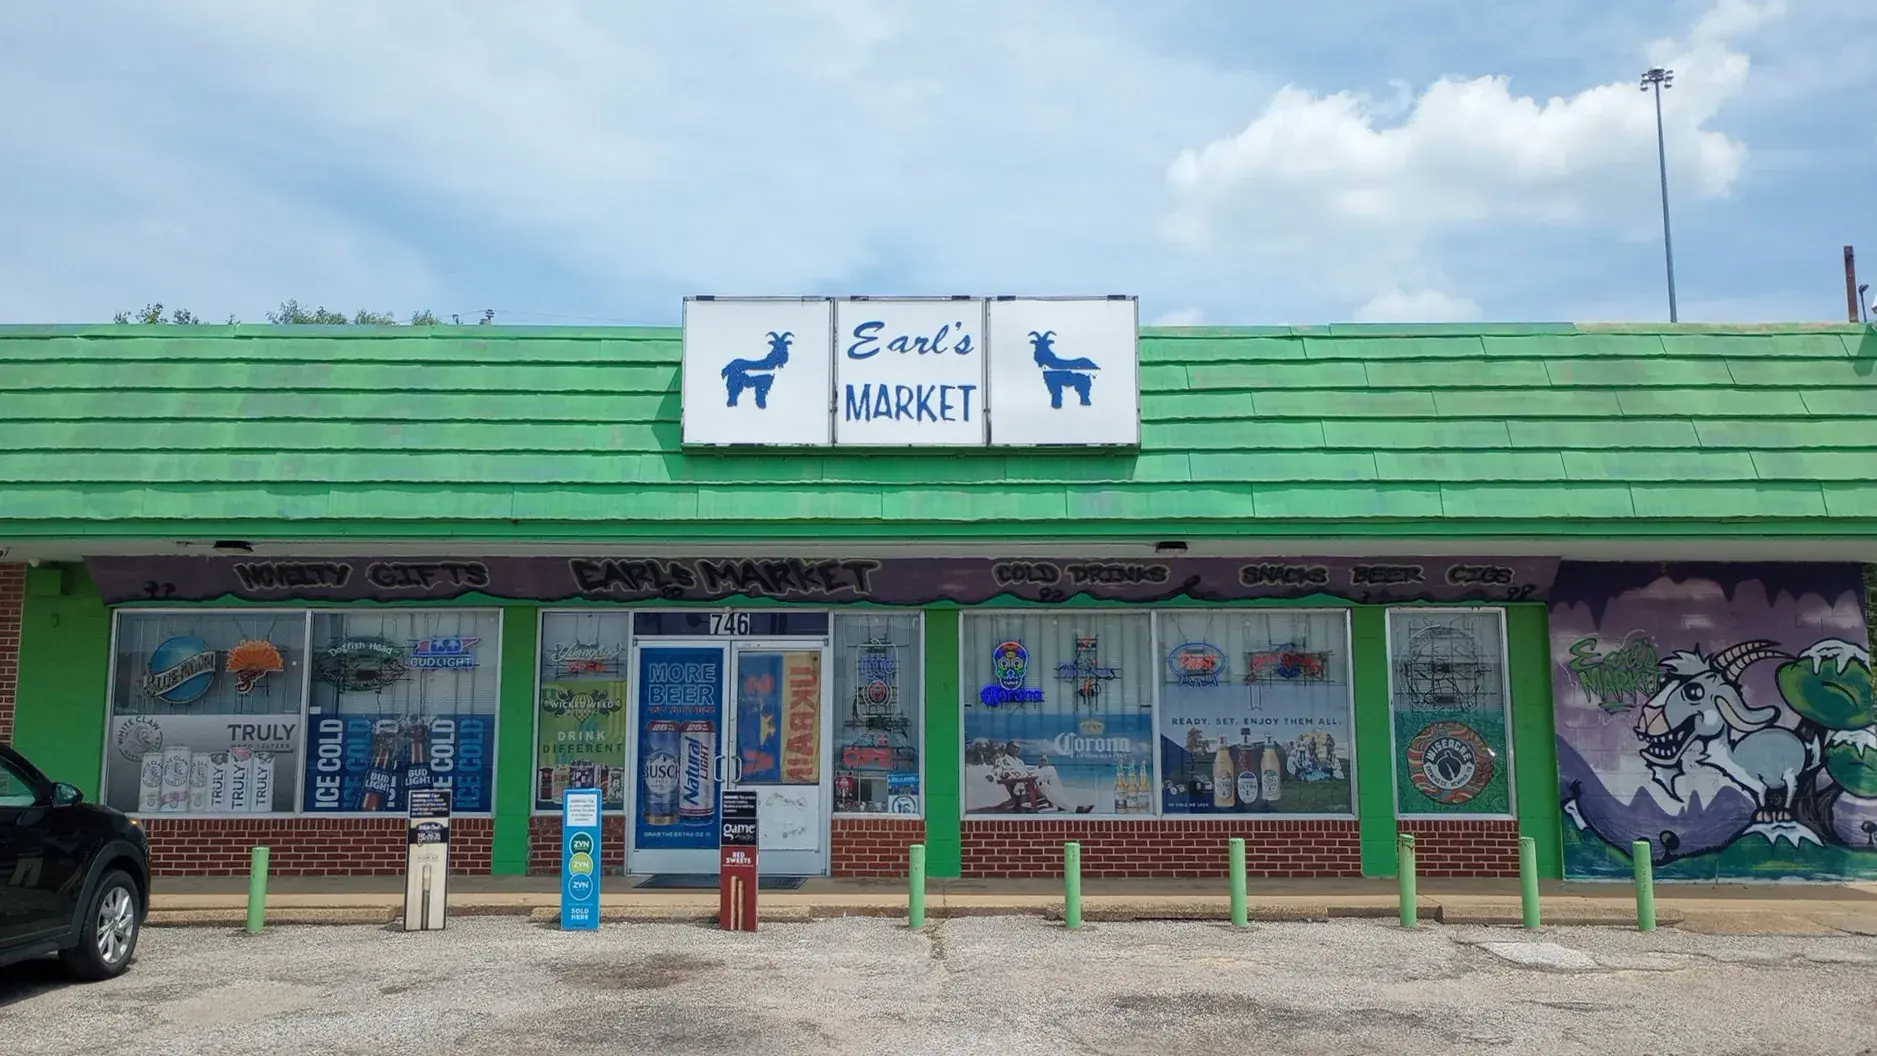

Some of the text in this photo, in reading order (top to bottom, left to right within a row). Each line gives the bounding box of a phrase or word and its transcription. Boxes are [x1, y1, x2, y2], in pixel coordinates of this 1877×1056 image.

[847, 320, 974, 360] Earl's
[845, 383, 977, 422] MARKET
[234, 561, 489, 591] NOVELTY GIFTS
[695, 557, 881, 596] MARKET
[992, 562, 1170, 586] COLD DRINKS
[1239, 562, 1330, 587] SNACKS
[1352, 563, 1425, 585] BEER
[1446, 564, 1514, 586] CIGS
[711, 613, 749, 635] 746
[329, 641, 393, 657] Dogfish Head
[410, 656, 473, 668] BUD LIGHT
[649, 663, 716, 683] MORE
[550, 700, 613, 709] WICKED WEED
[649, 684, 714, 705] BEER
[117, 715, 161, 746] WHITE CLAW
[227, 723, 296, 742] TRULY
[1172, 717, 1343, 726] READY. SET. ENJOY THEM ALL.
[430, 719, 456, 772] COLD
[558, 731, 605, 741] DRINK
[1053, 732, 1131, 757] Corona
[542, 744, 623, 754] DIFFERENT
[1425, 738, 1472, 762] WISEACRE
[315, 719, 343, 808] ICE COLD
[408, 768, 428, 778] BUD
[456, 719, 484, 808] ICE COLD
[683, 736, 700, 806] Natural
[700, 745, 709, 780] LIGHT
[211, 766, 224, 806] TRULY
[231, 764, 246, 810] TRULY
[255, 766, 268, 806] TRULY
[365, 779, 390, 791] LIGHT
[370, 772, 390, 783] BUD
[405, 776, 431, 786] LIGHT
[723, 823, 756, 840] game
[573, 840, 589, 848] ZYN
[573, 860, 589, 868] ZYN
[572, 881, 589, 889] ZYN
